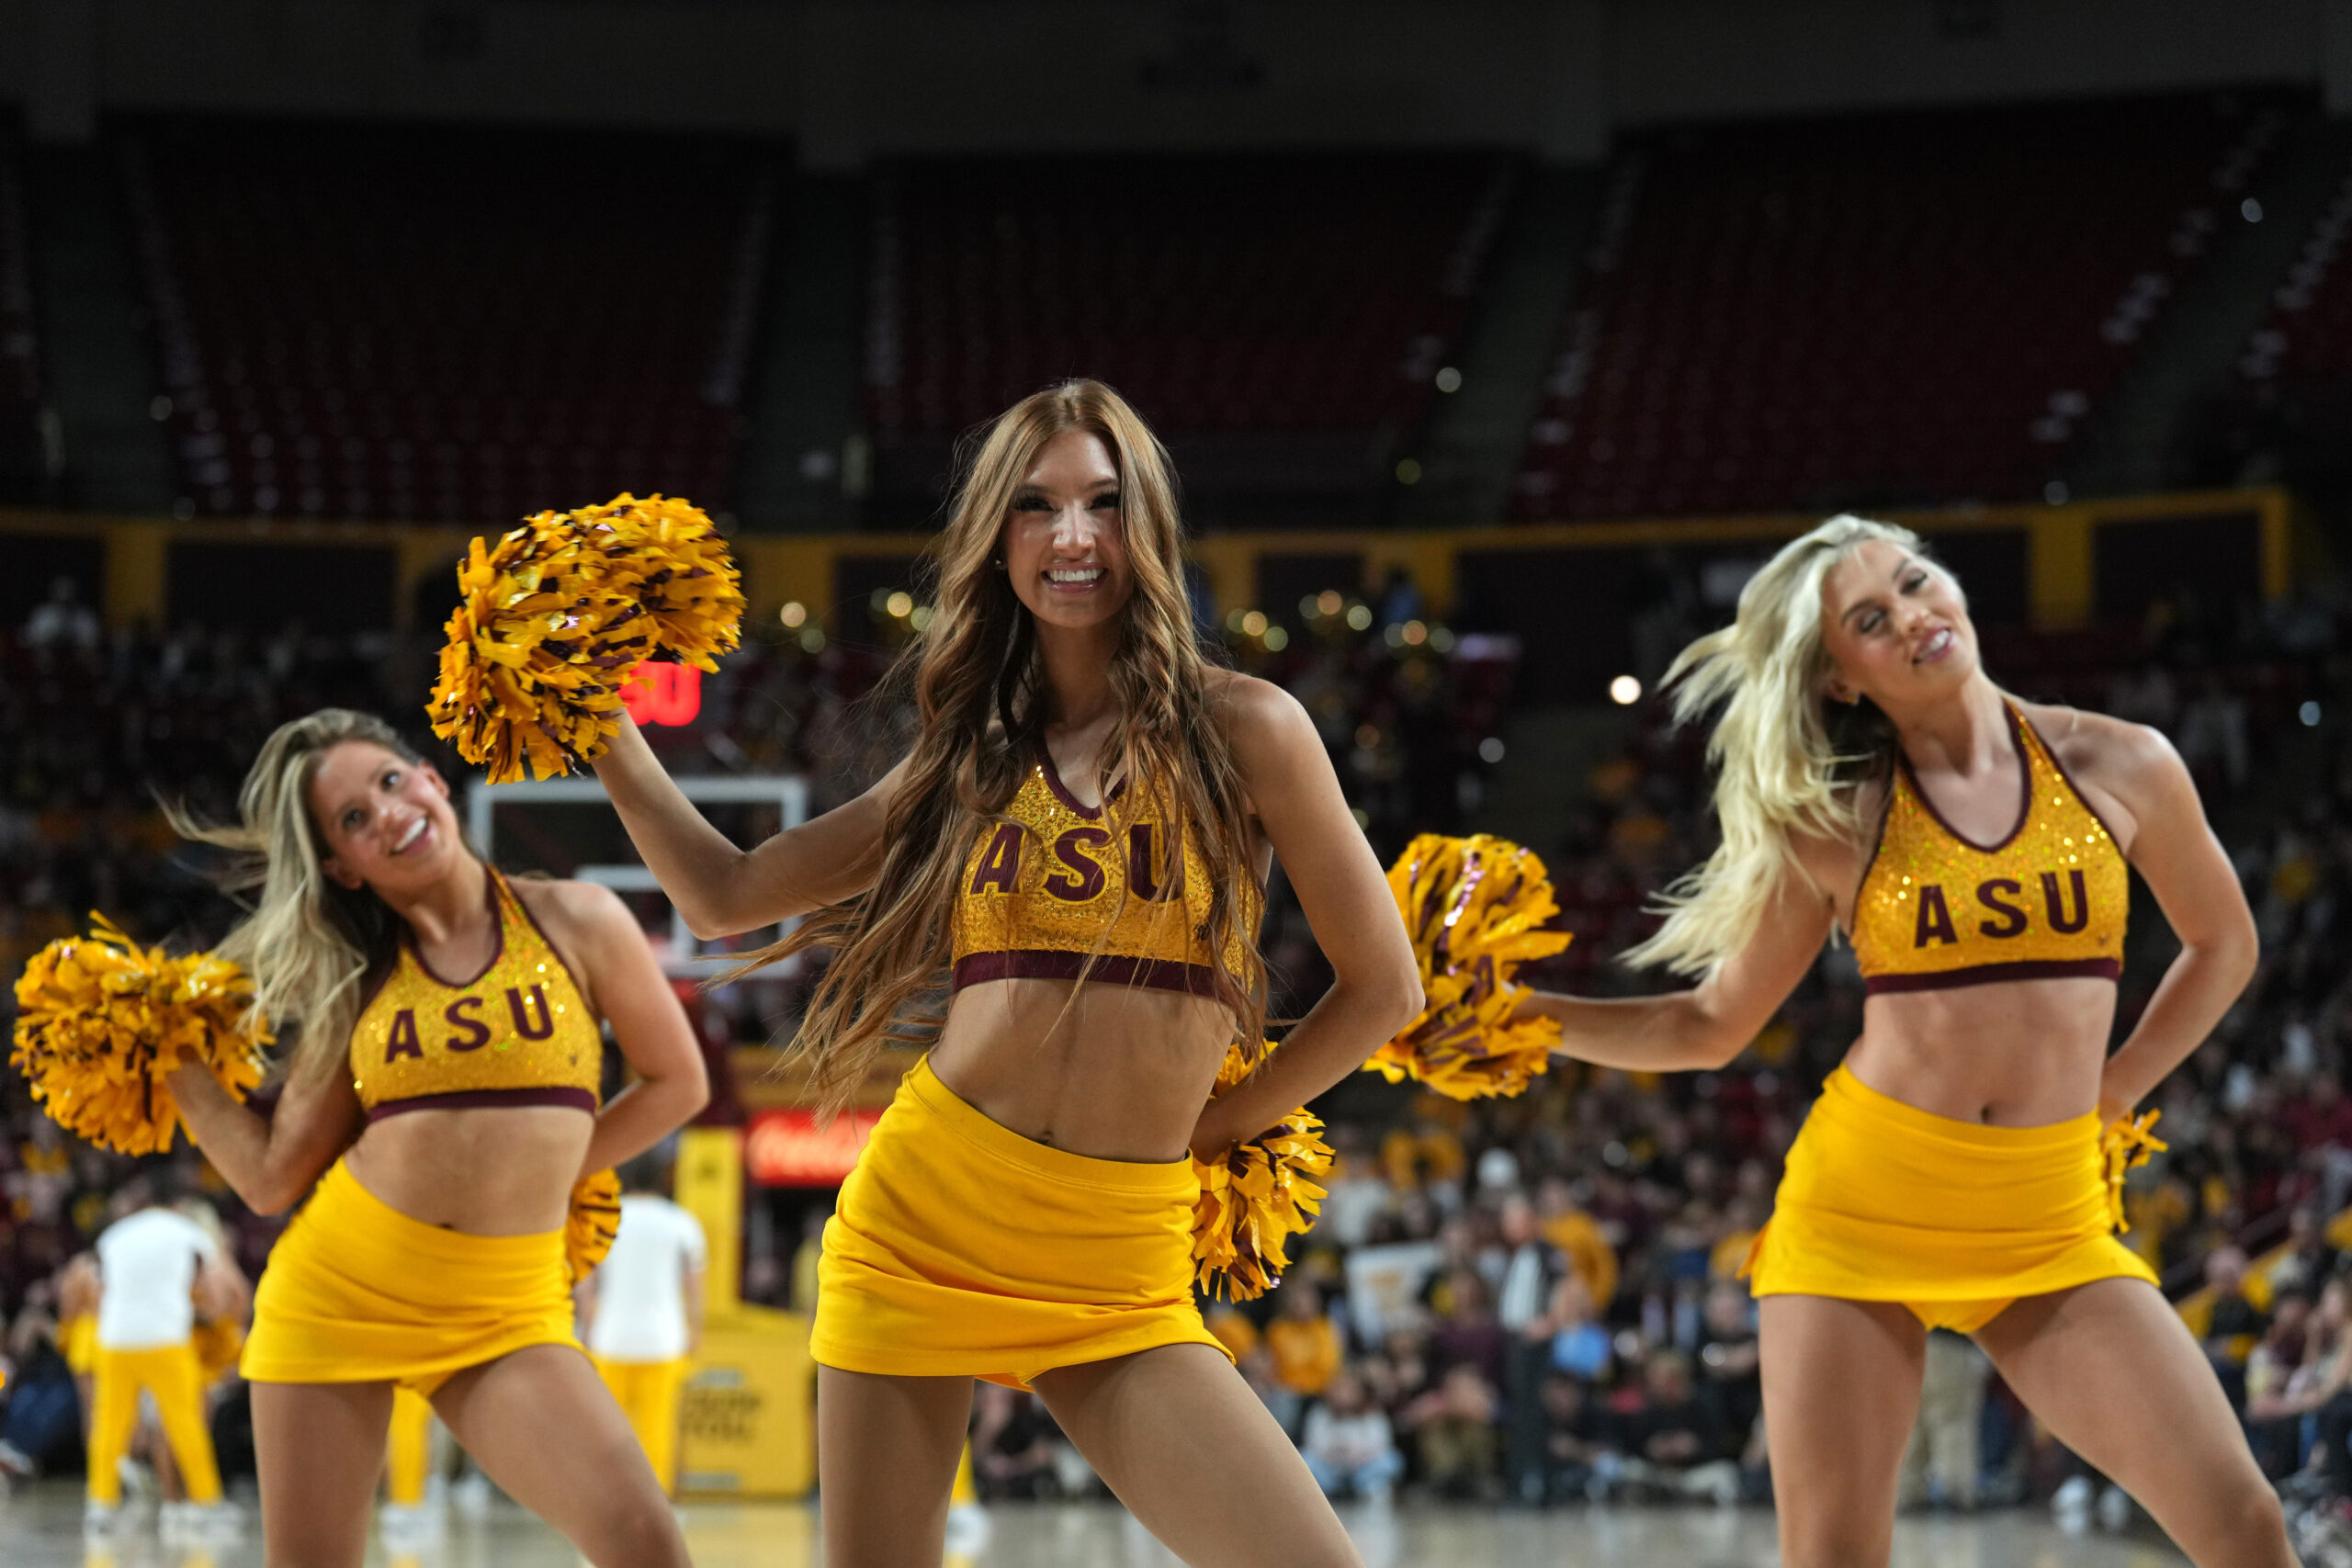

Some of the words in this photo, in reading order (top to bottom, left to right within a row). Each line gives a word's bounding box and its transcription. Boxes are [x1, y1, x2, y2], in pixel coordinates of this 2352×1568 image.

[968, 821, 1186, 903] ASU
[1914, 869, 2088, 949] ASU
[384, 984, 555, 1064] ASU
